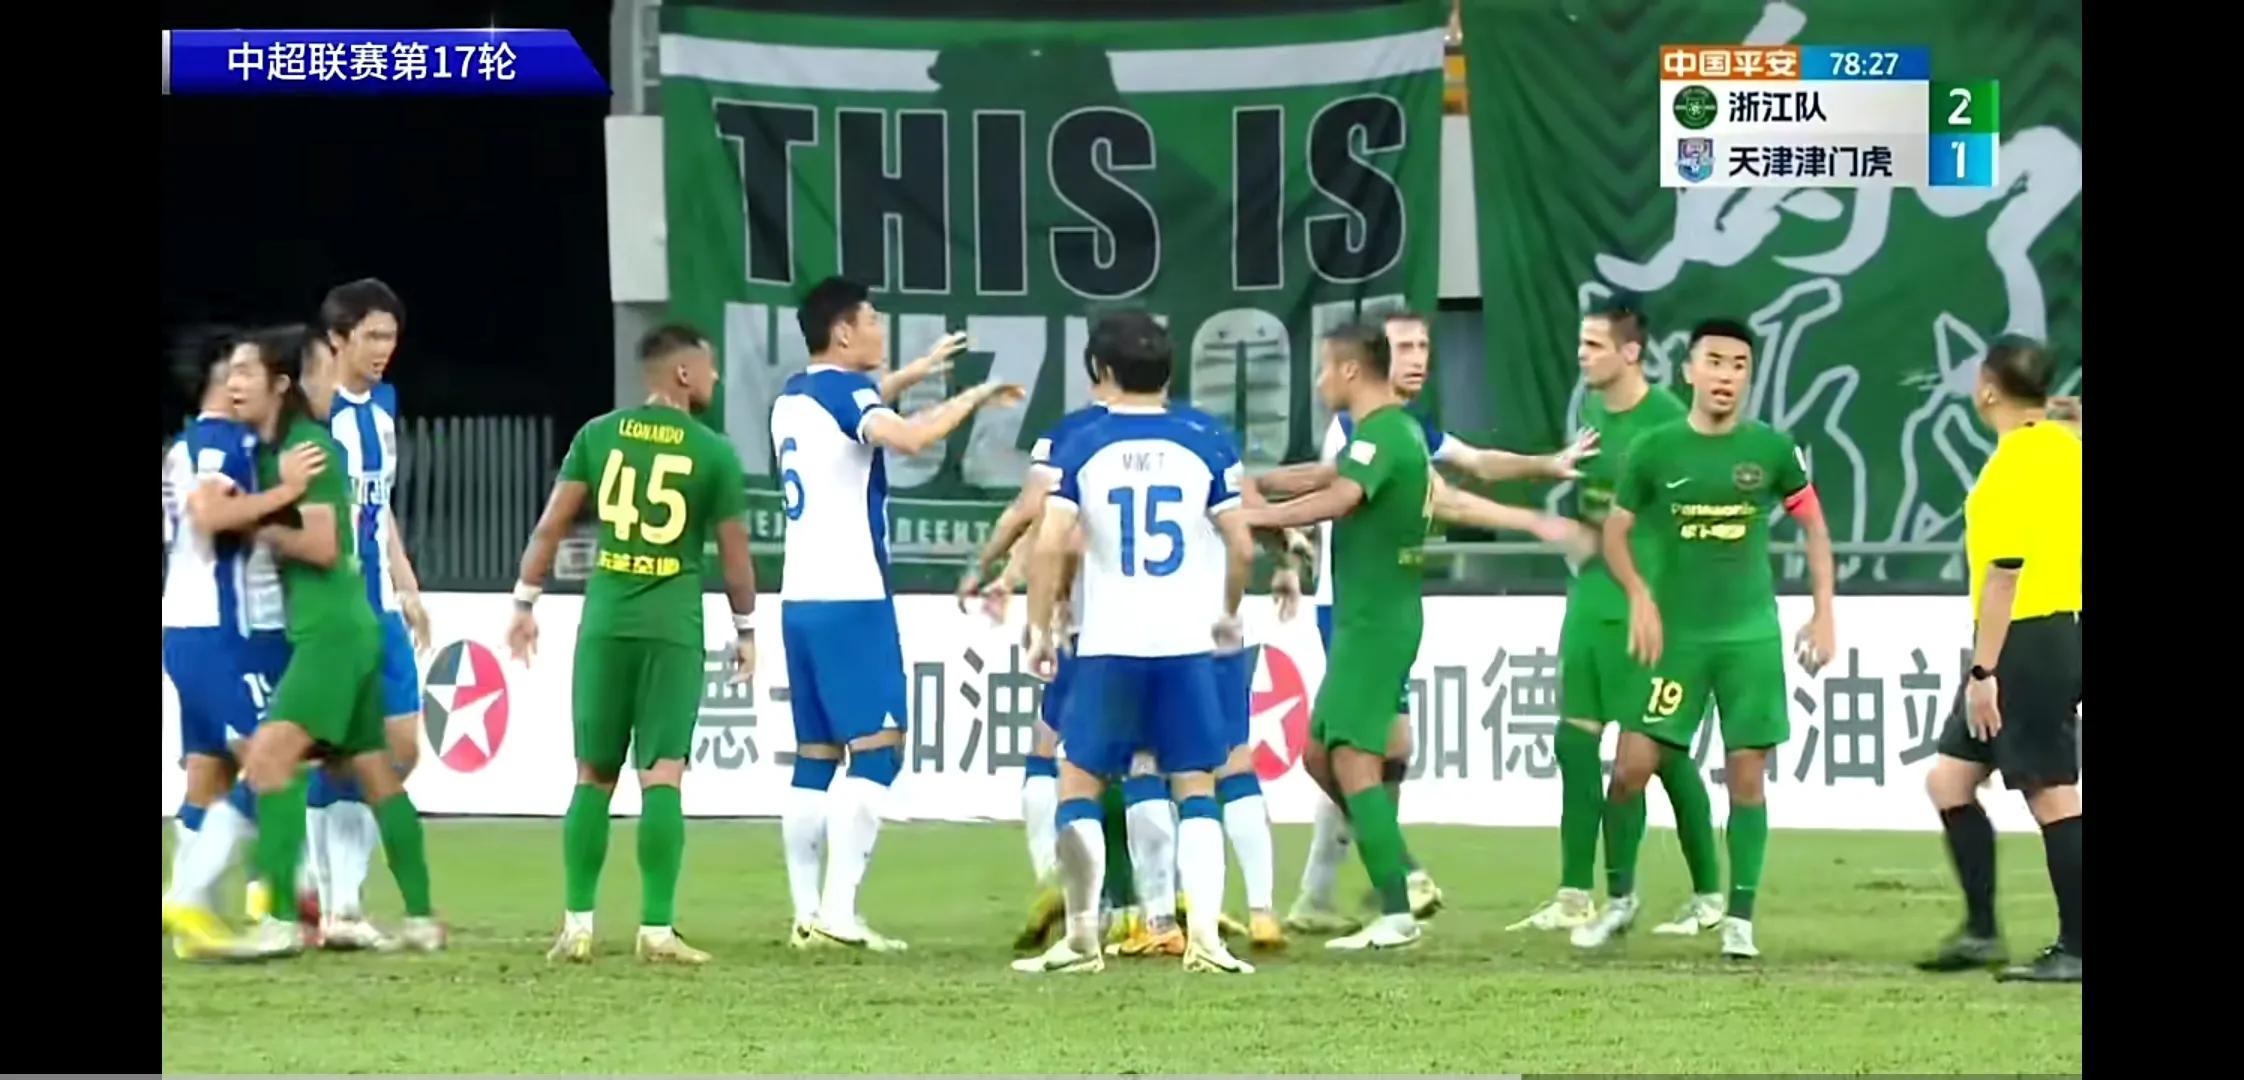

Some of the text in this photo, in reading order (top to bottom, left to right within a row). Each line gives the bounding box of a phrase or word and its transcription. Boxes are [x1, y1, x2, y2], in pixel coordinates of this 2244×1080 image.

[711, 93, 1407, 300] THIS IS
[618, 418, 685, 445] LEONARDO
[598, 449, 693, 545] 45
[1108, 484, 1185, 577] 15
[1648, 676, 1683, 716] 19
